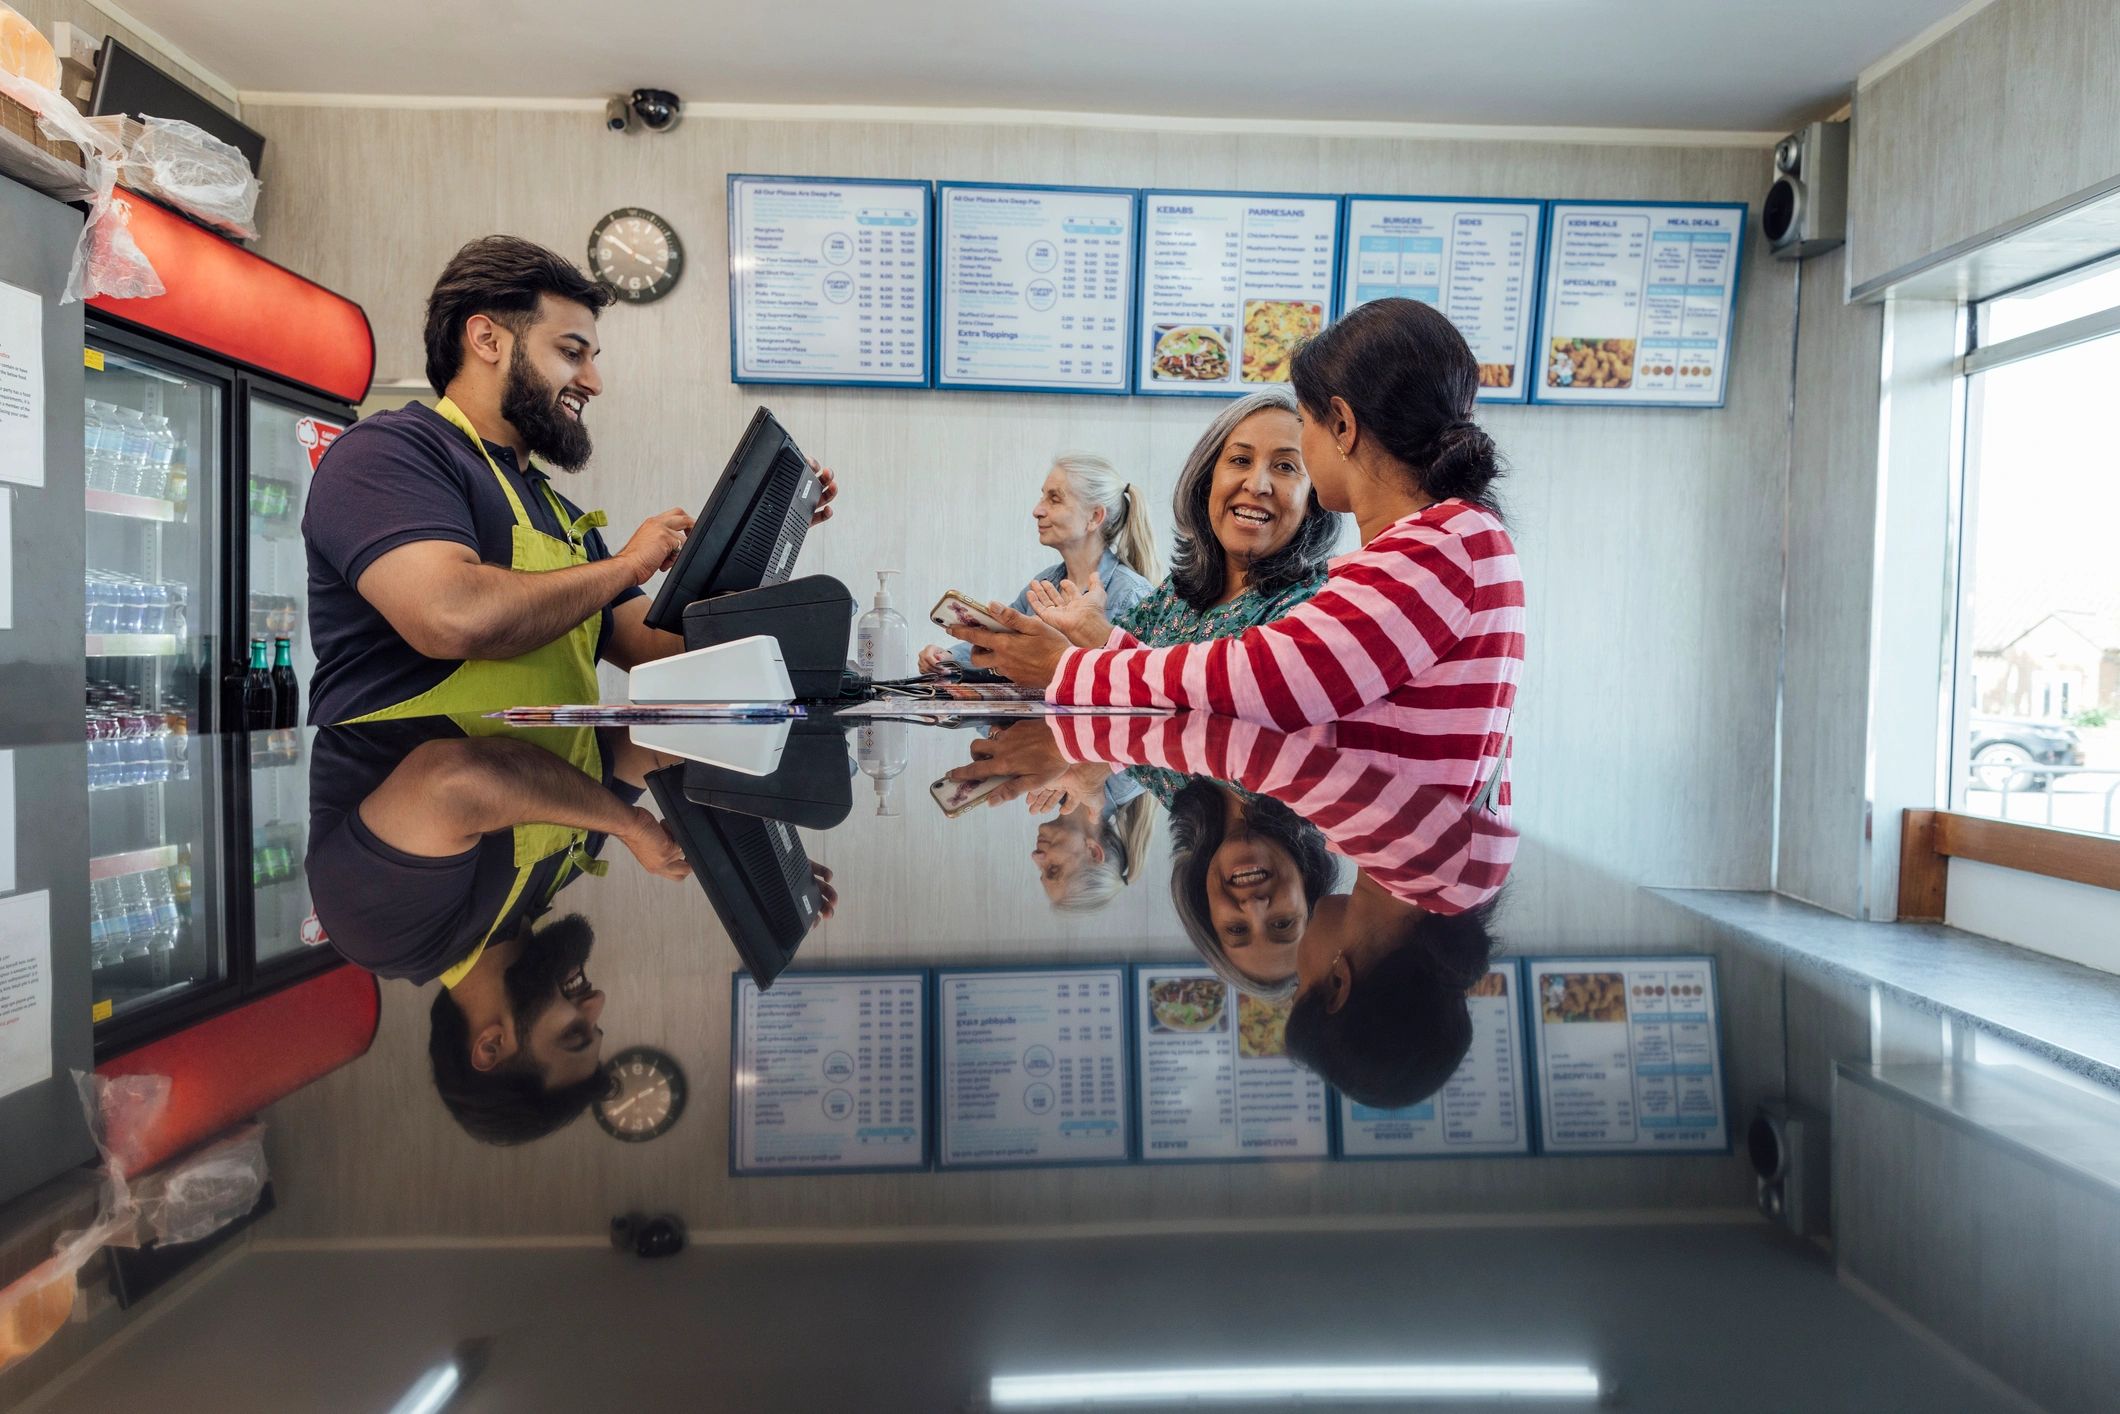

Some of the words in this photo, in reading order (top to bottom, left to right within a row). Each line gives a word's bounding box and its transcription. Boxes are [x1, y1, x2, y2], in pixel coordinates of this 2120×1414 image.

[1156, 206, 1194, 214] KEBABS
[1248, 208, 1305, 217] PARMESANS
[600, 248, 612, 260] 9
[628, 276, 641, 290] 6
[982, 330, 1018, 340] Toppings
